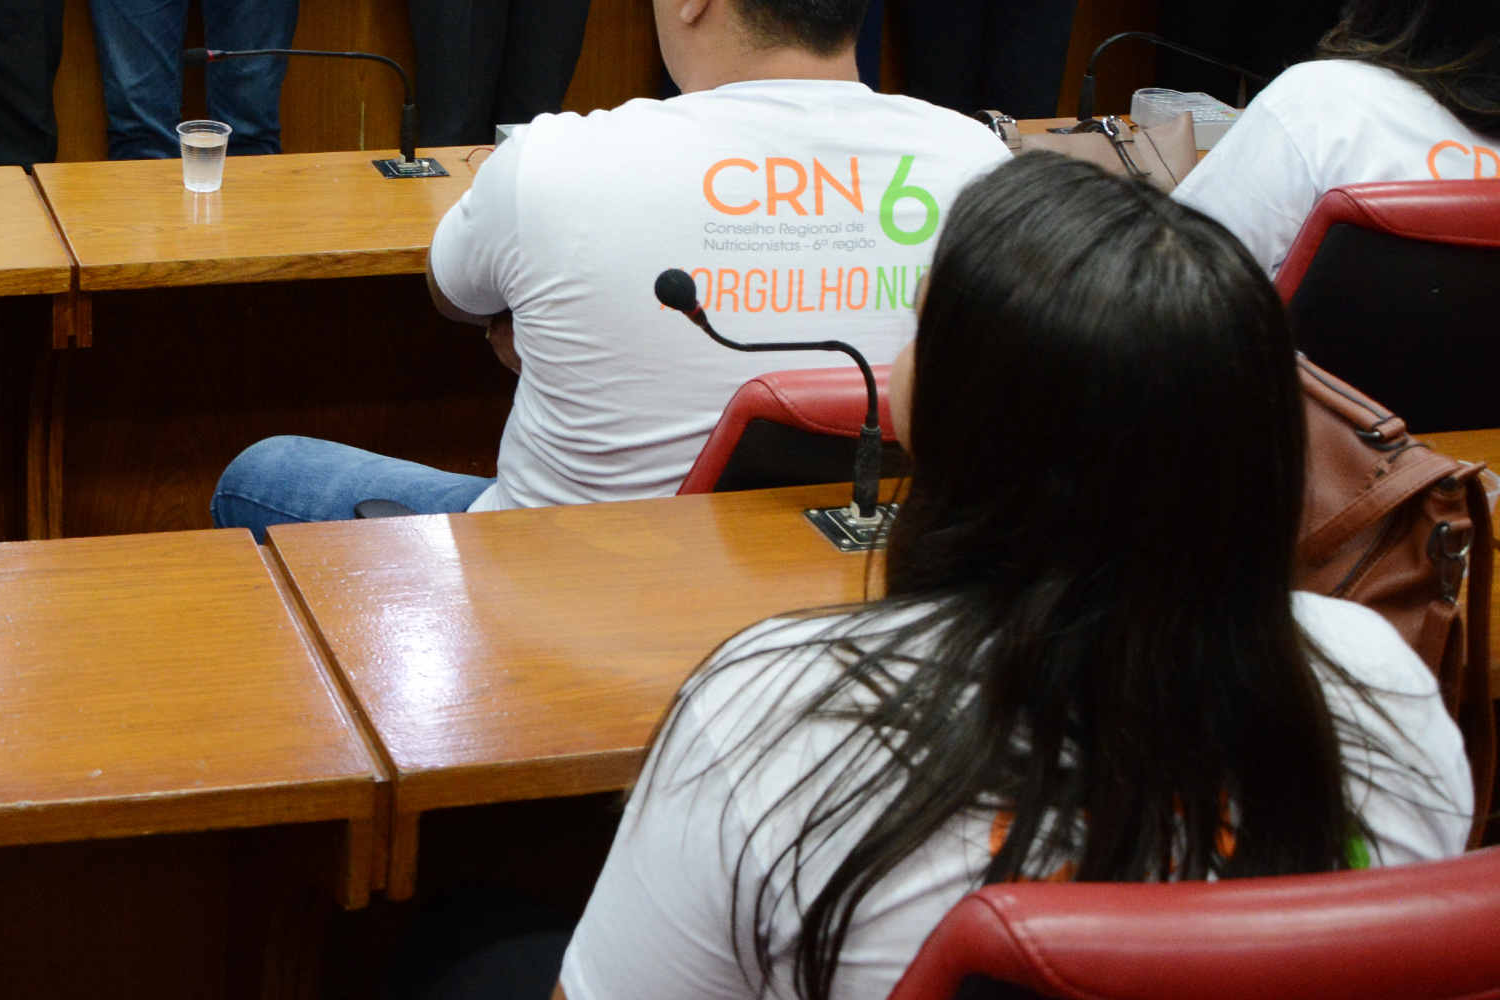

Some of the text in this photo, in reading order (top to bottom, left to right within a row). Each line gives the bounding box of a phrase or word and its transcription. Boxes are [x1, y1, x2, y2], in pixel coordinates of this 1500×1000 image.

[703, 221, 865, 238] Conselho Regional de
[703, 238, 801, 252] Nutricionistas
[832, 237, 877, 252] região
